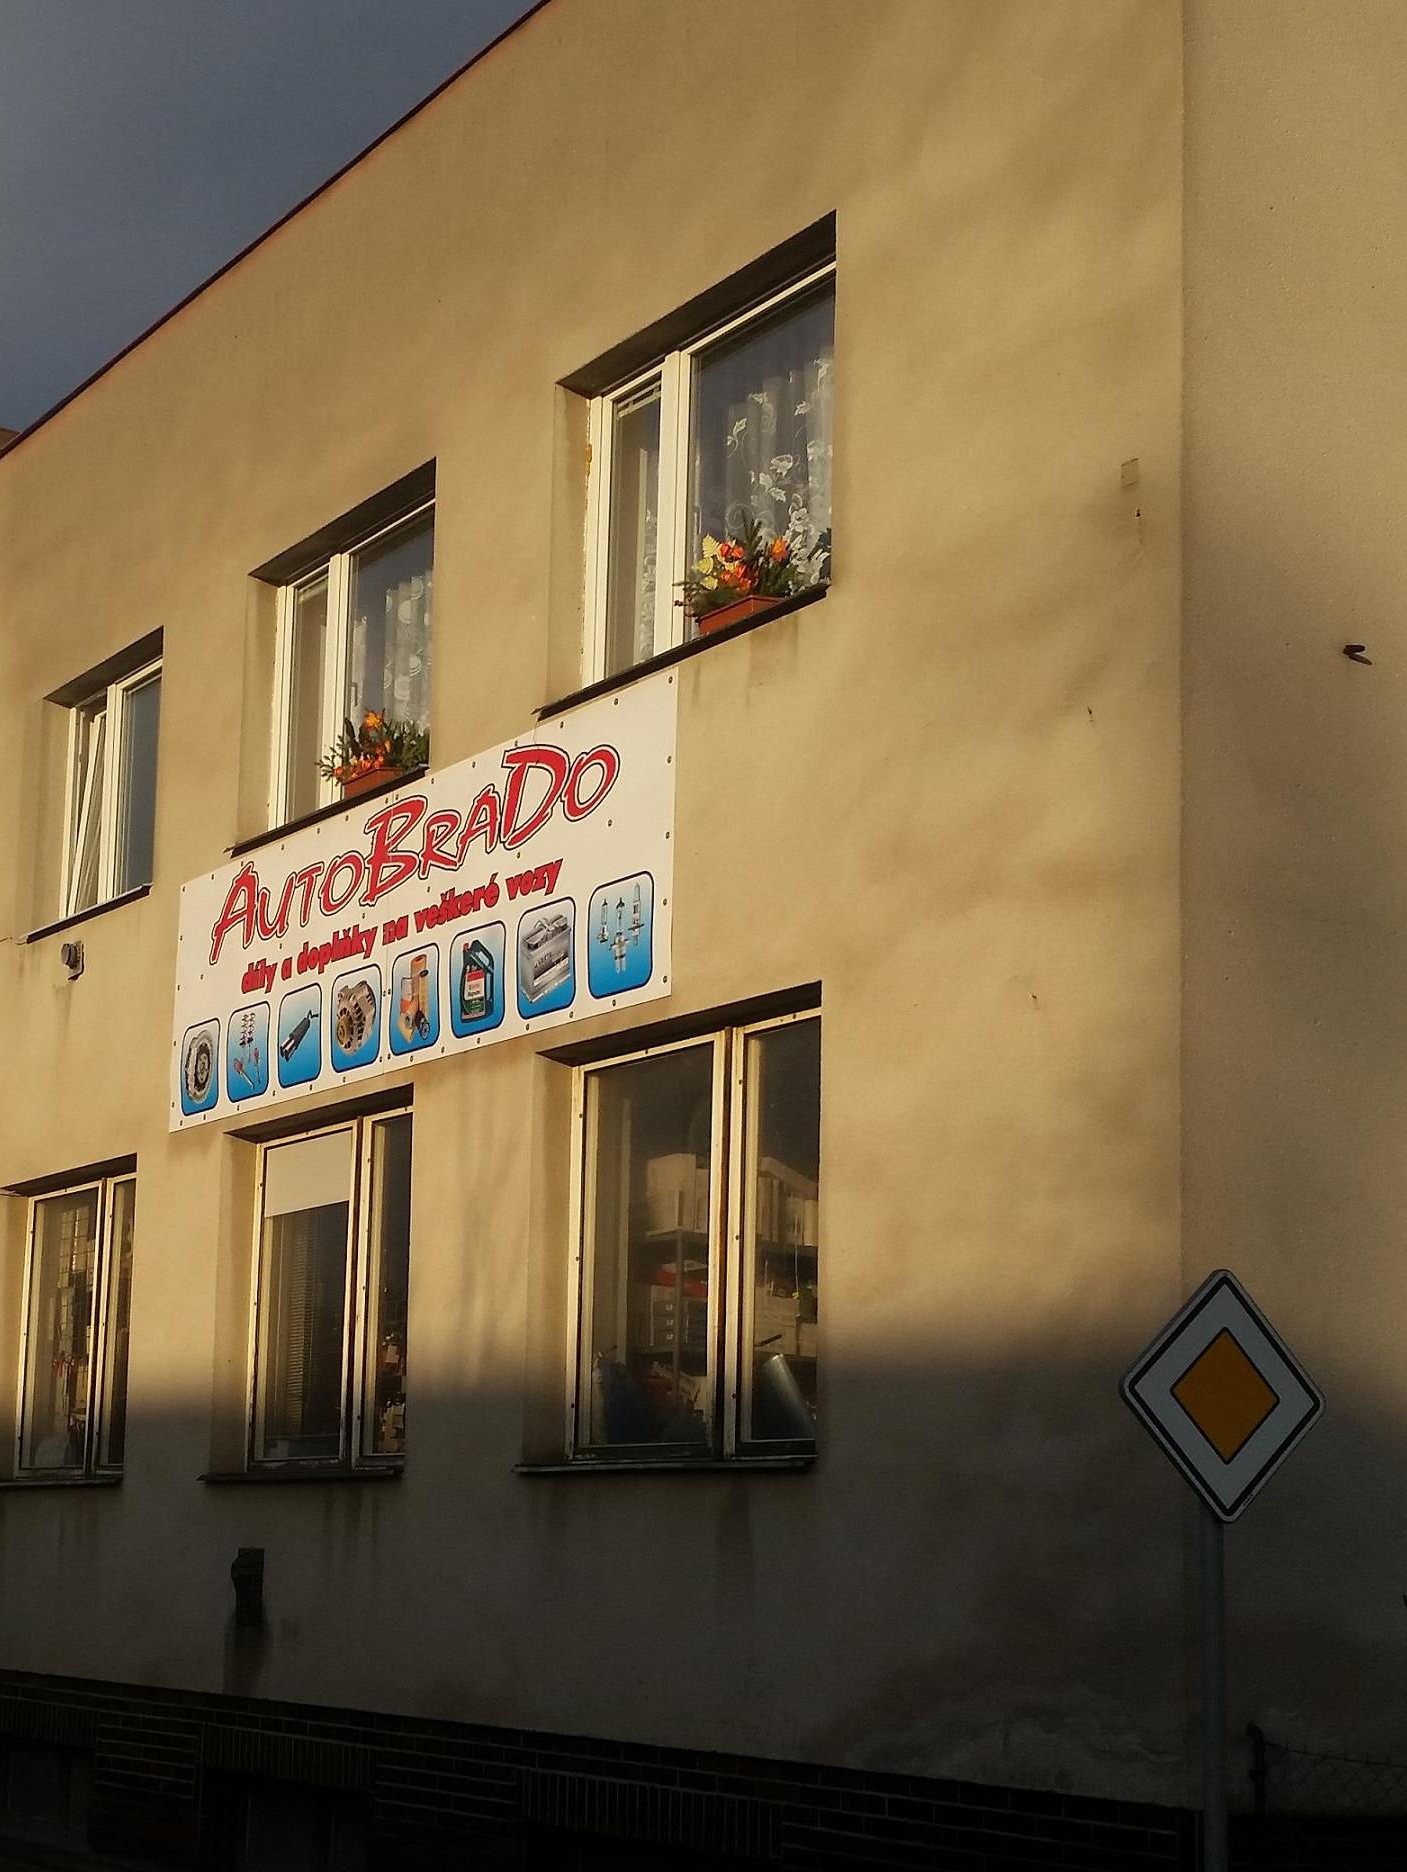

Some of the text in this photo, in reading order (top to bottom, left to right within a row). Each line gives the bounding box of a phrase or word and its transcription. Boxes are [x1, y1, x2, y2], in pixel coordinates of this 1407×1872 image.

[281, 956, 293, 981] a
[296, 923, 379, 975] doplňky
[382, 914, 409, 946] na
[413, 871, 500, 934] veškeré
[505, 858, 564, 901] vozy
